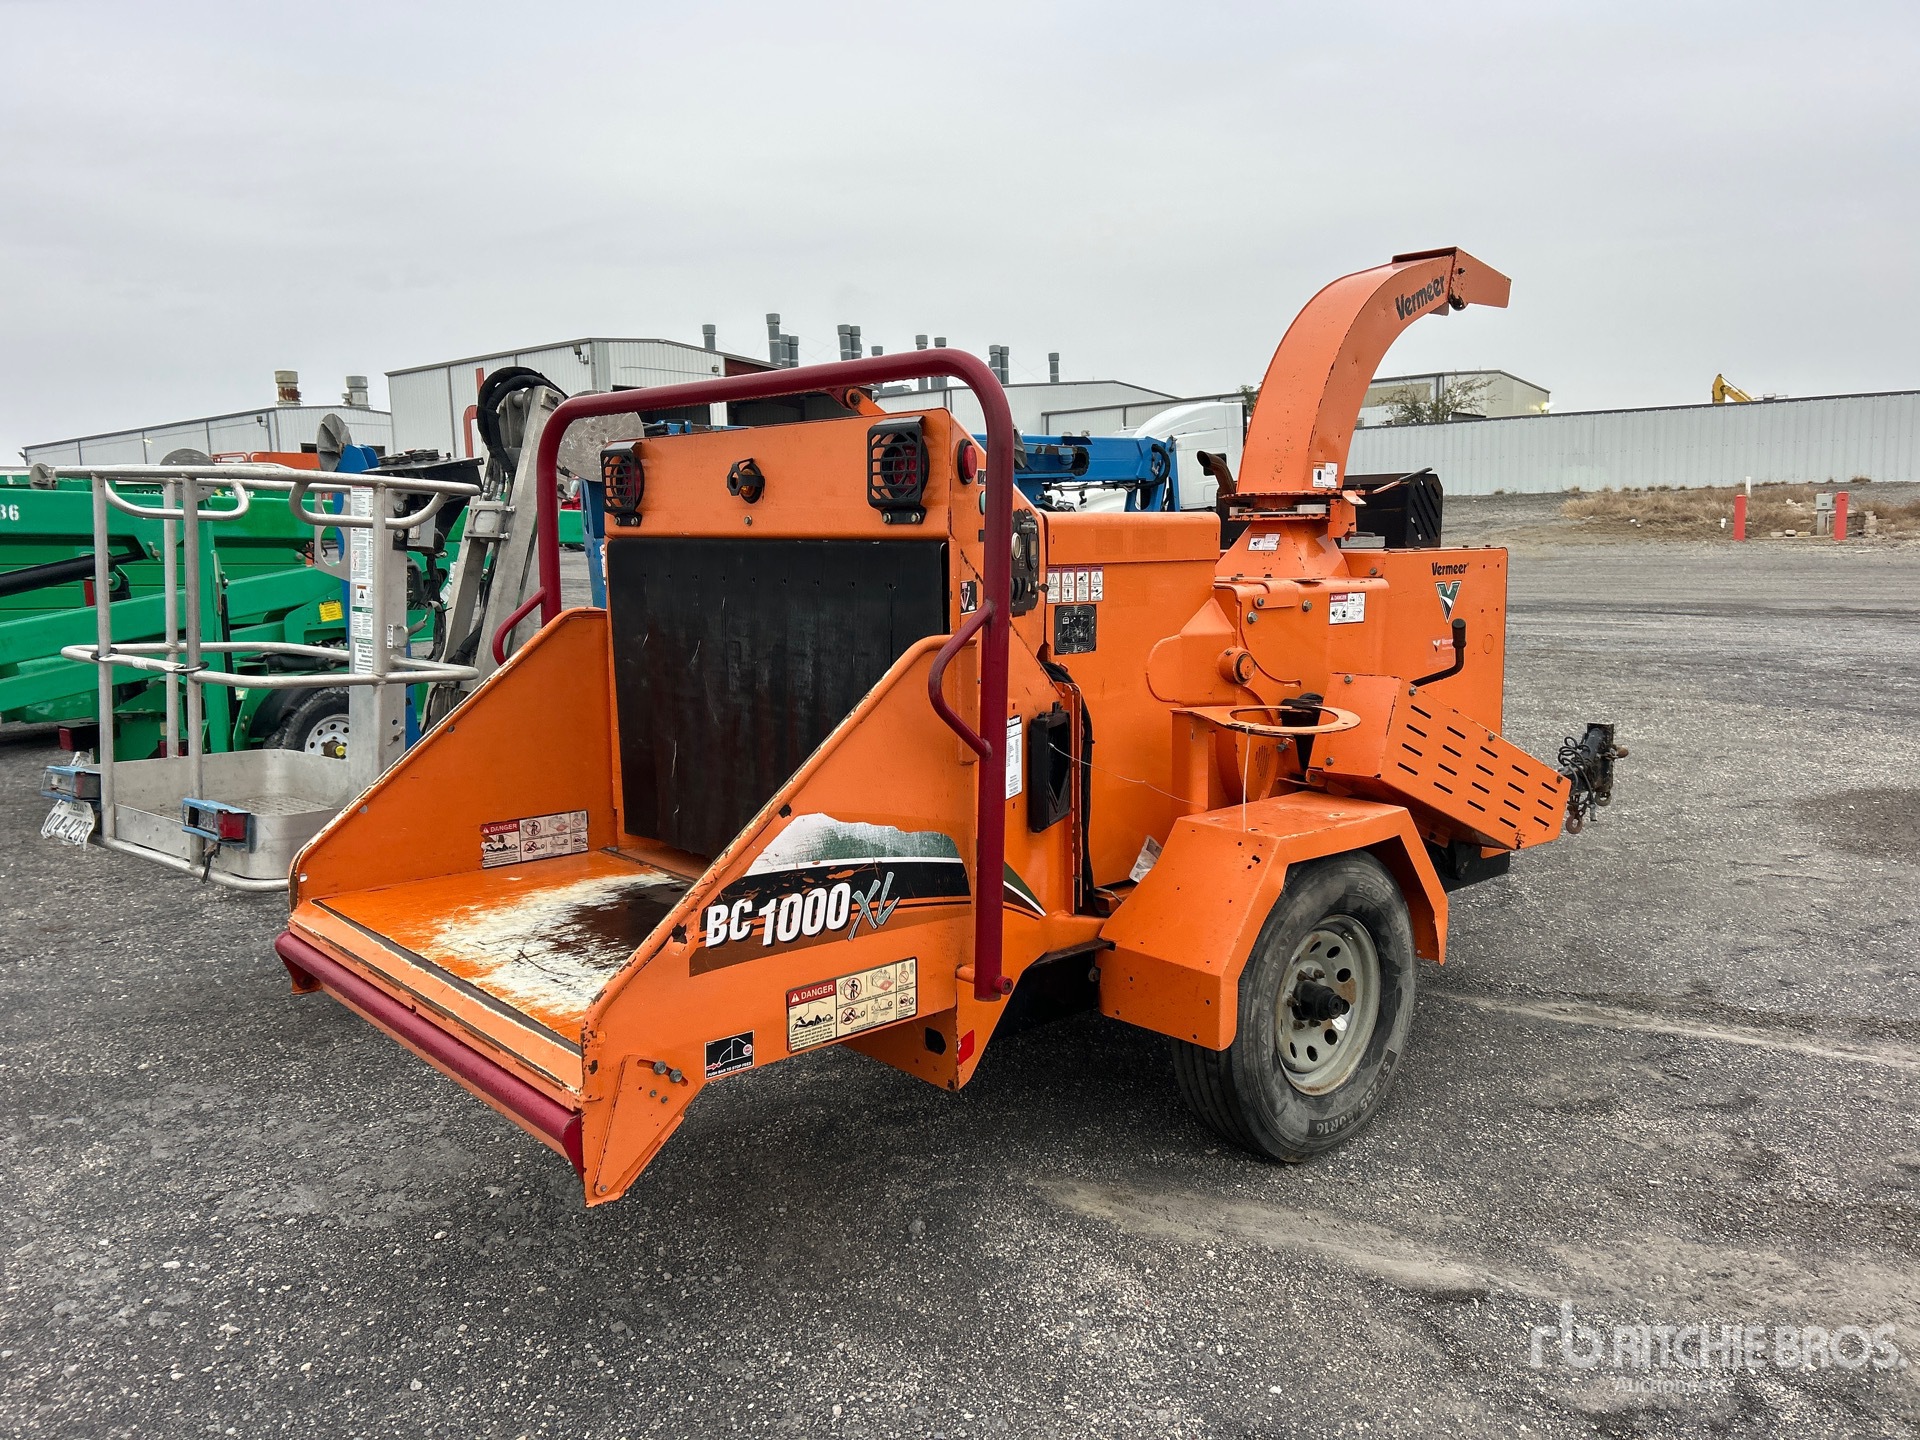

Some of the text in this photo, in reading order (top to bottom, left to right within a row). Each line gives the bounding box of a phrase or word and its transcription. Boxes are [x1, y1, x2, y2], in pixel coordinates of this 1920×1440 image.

[1395, 275, 1445, 321] Vermeer
[1431, 562, 1467, 576] Vermeer
[490, 823, 518, 832] DANGER
[705, 871, 900, 948] BC 1000 XL
[801, 984, 834, 1000] DANGER
